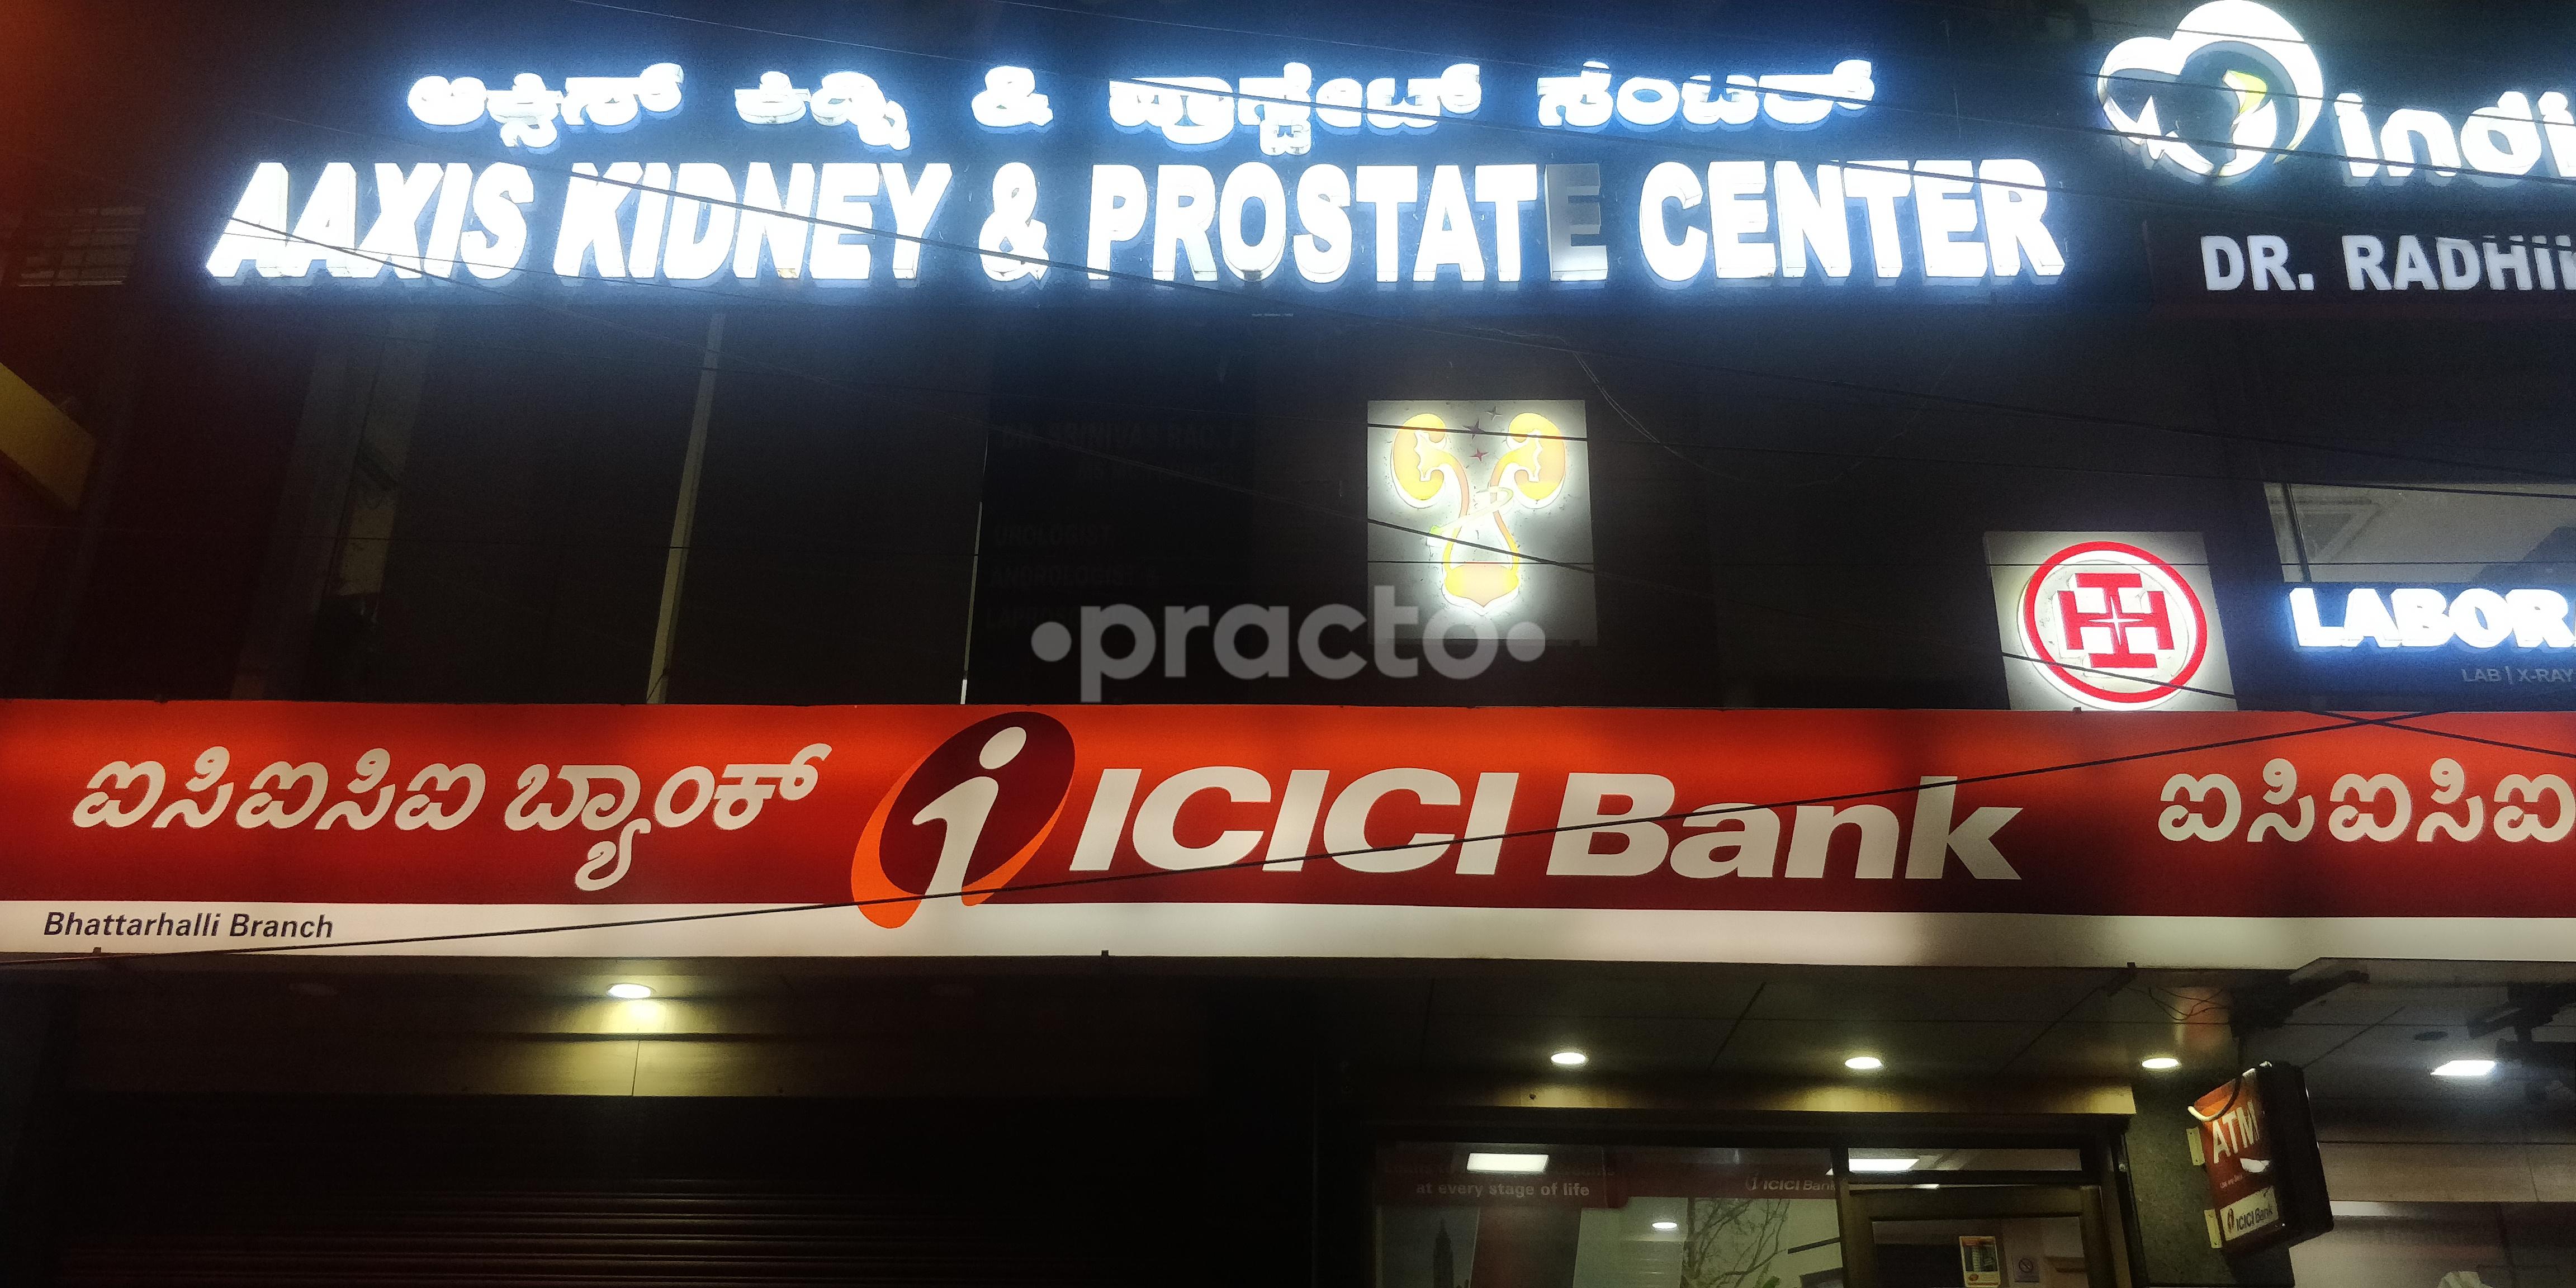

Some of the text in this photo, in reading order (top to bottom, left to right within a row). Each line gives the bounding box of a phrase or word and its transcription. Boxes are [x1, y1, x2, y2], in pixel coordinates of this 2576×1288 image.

[972, 66, 1054, 126] &
[2334, 91, 2576, 177] indi
[206, 159, 2066, 283] AAXIS KIDNEY & PROSTATE CENTER
[2200, 235, 2314, 291] DR.
[2289, 588, 2576, 648] LABOR
[2461, 668, 2502, 683] LAB
[2516, 667, 2574, 684] X-RAY
[72, 743, 832, 891] ಐಸಿಐಸಿಐ ಬ್ಯಾಂಕ್
[1069, 766, 1519, 875] ICICI
[1546, 772, 2023, 880] Bank
[2158, 757, 2576, 842] ಐಸಿಐಸಿಐ
[44, 912, 334, 939] Bhattarhalli Branch
[2212, 1100, 2260, 1164] ATM
[1416, 1181, 1590, 1198] at every stage of life
[1763, 1180, 1800, 1190] ICICI
[2236, 1204, 2273, 1231] ICICI Bank
